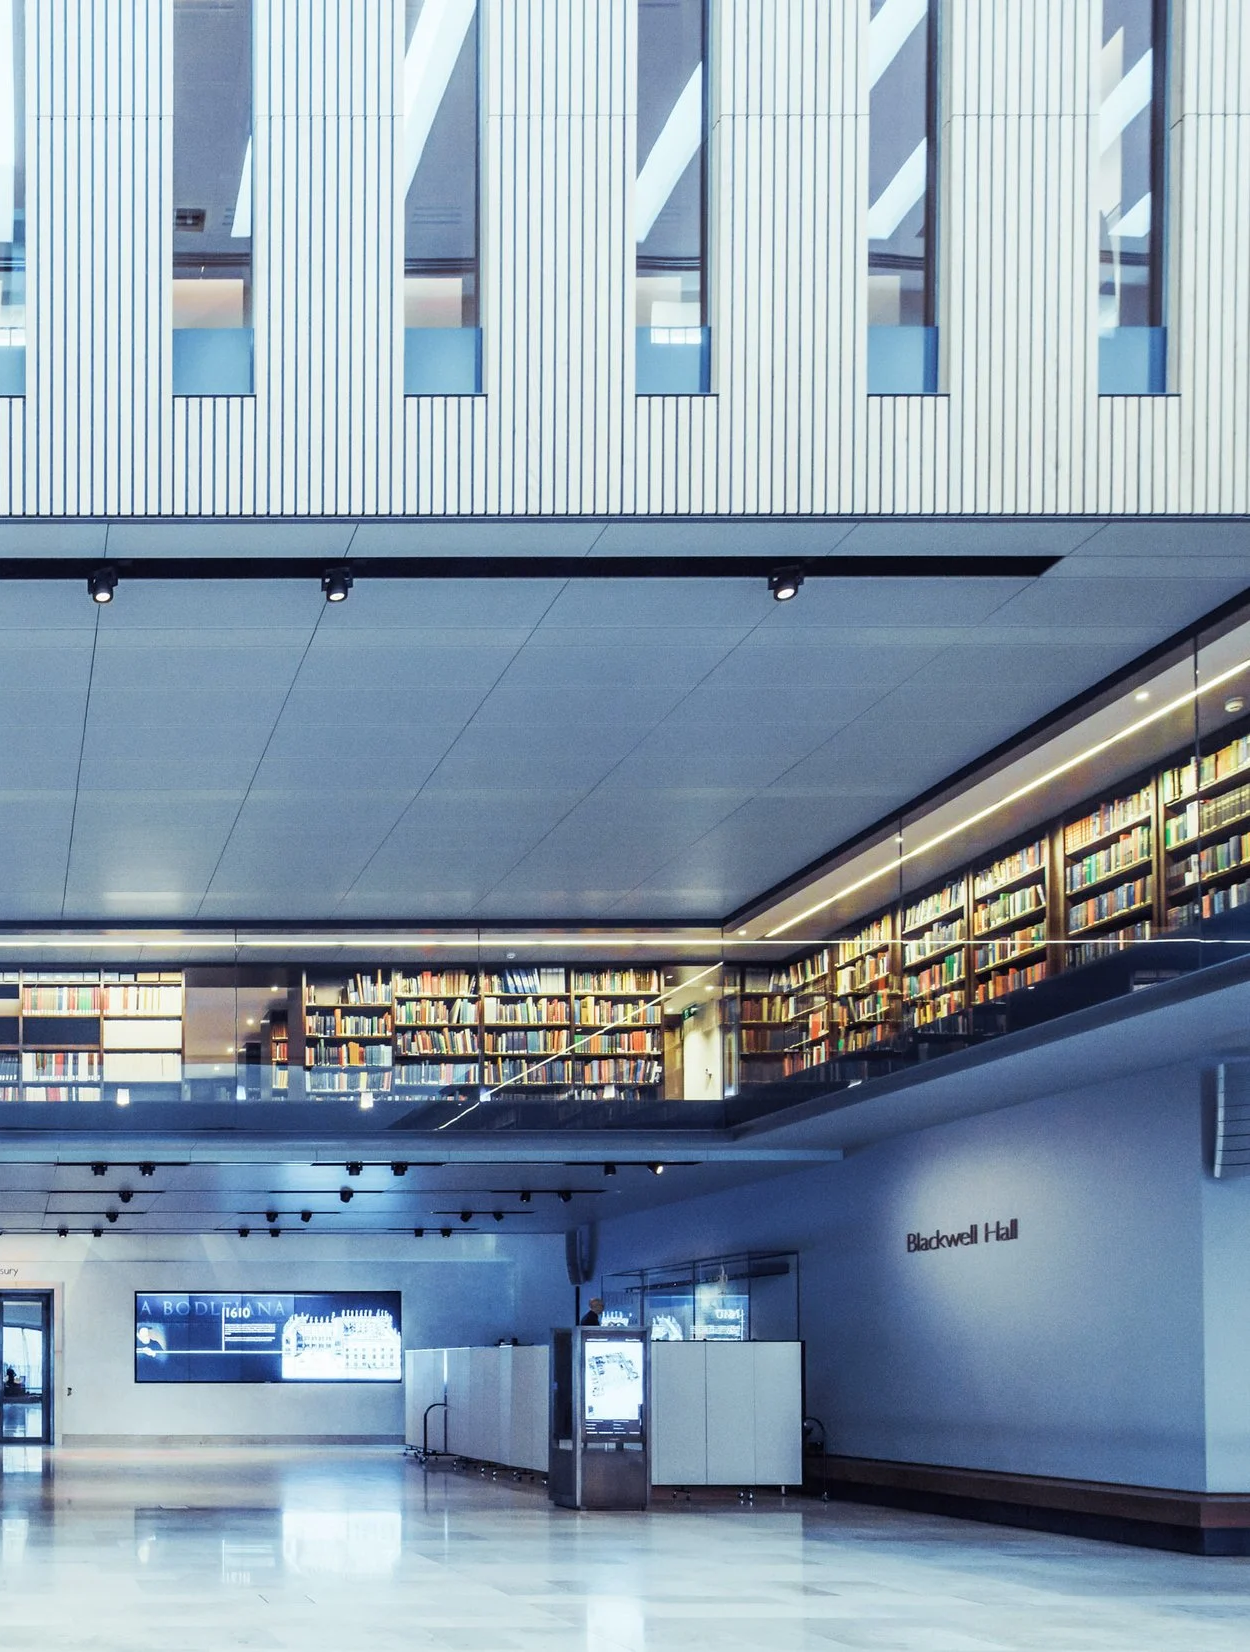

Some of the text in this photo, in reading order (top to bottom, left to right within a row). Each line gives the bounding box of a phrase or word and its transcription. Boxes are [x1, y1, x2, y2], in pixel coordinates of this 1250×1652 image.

[906, 1218, 1019, 1253] Blackwell Hall
[225, 1307, 251, 1318] 1610
